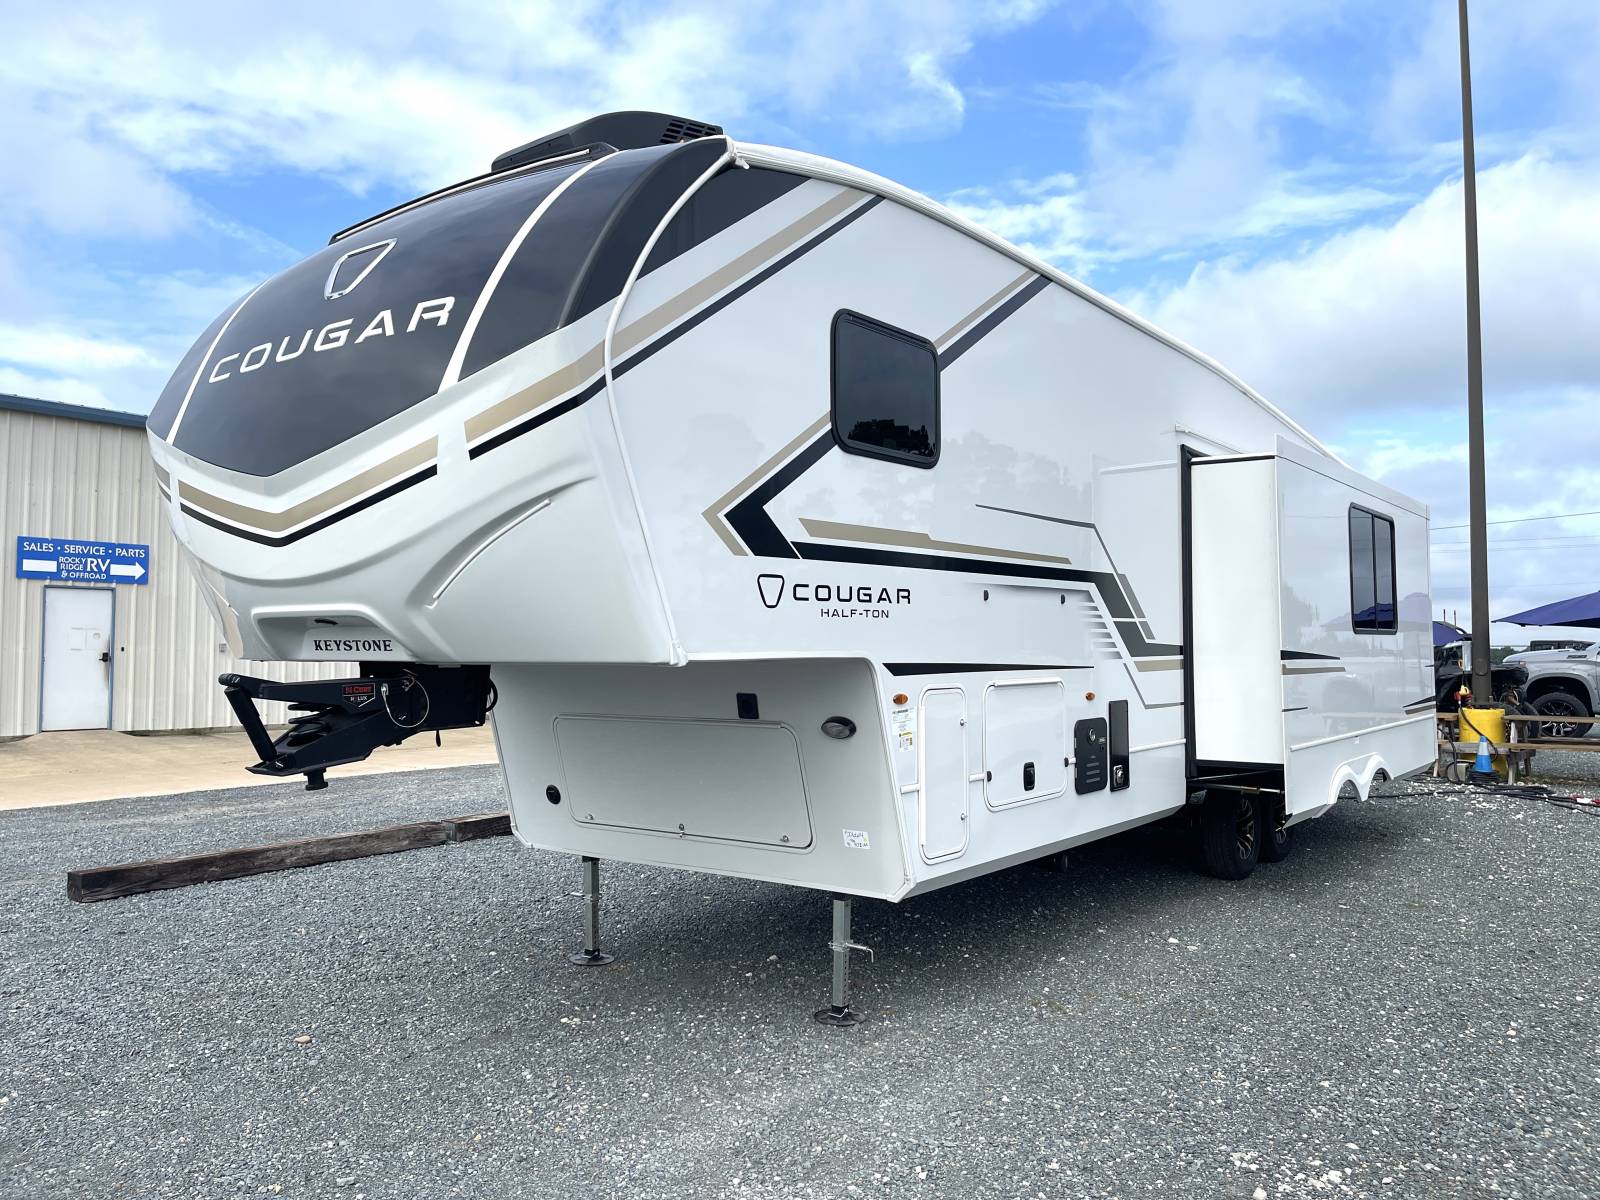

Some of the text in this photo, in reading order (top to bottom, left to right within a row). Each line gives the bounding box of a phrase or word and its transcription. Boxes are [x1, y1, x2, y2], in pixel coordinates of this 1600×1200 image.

[208, 295, 456, 384] COUGAR
[23, 541, 145, 558] SALES SERVICE PARTS
[58, 556, 86, 565] ROCKY
[60, 563, 84, 571] RIDGE
[86, 557, 111, 573] RV
[61, 570, 107, 580] & OFFROAD
[792, 583, 911, 605] COUGAR
[820, 608, 890, 619] HALF-TON
[313, 639, 393, 652] KEYSTONE
